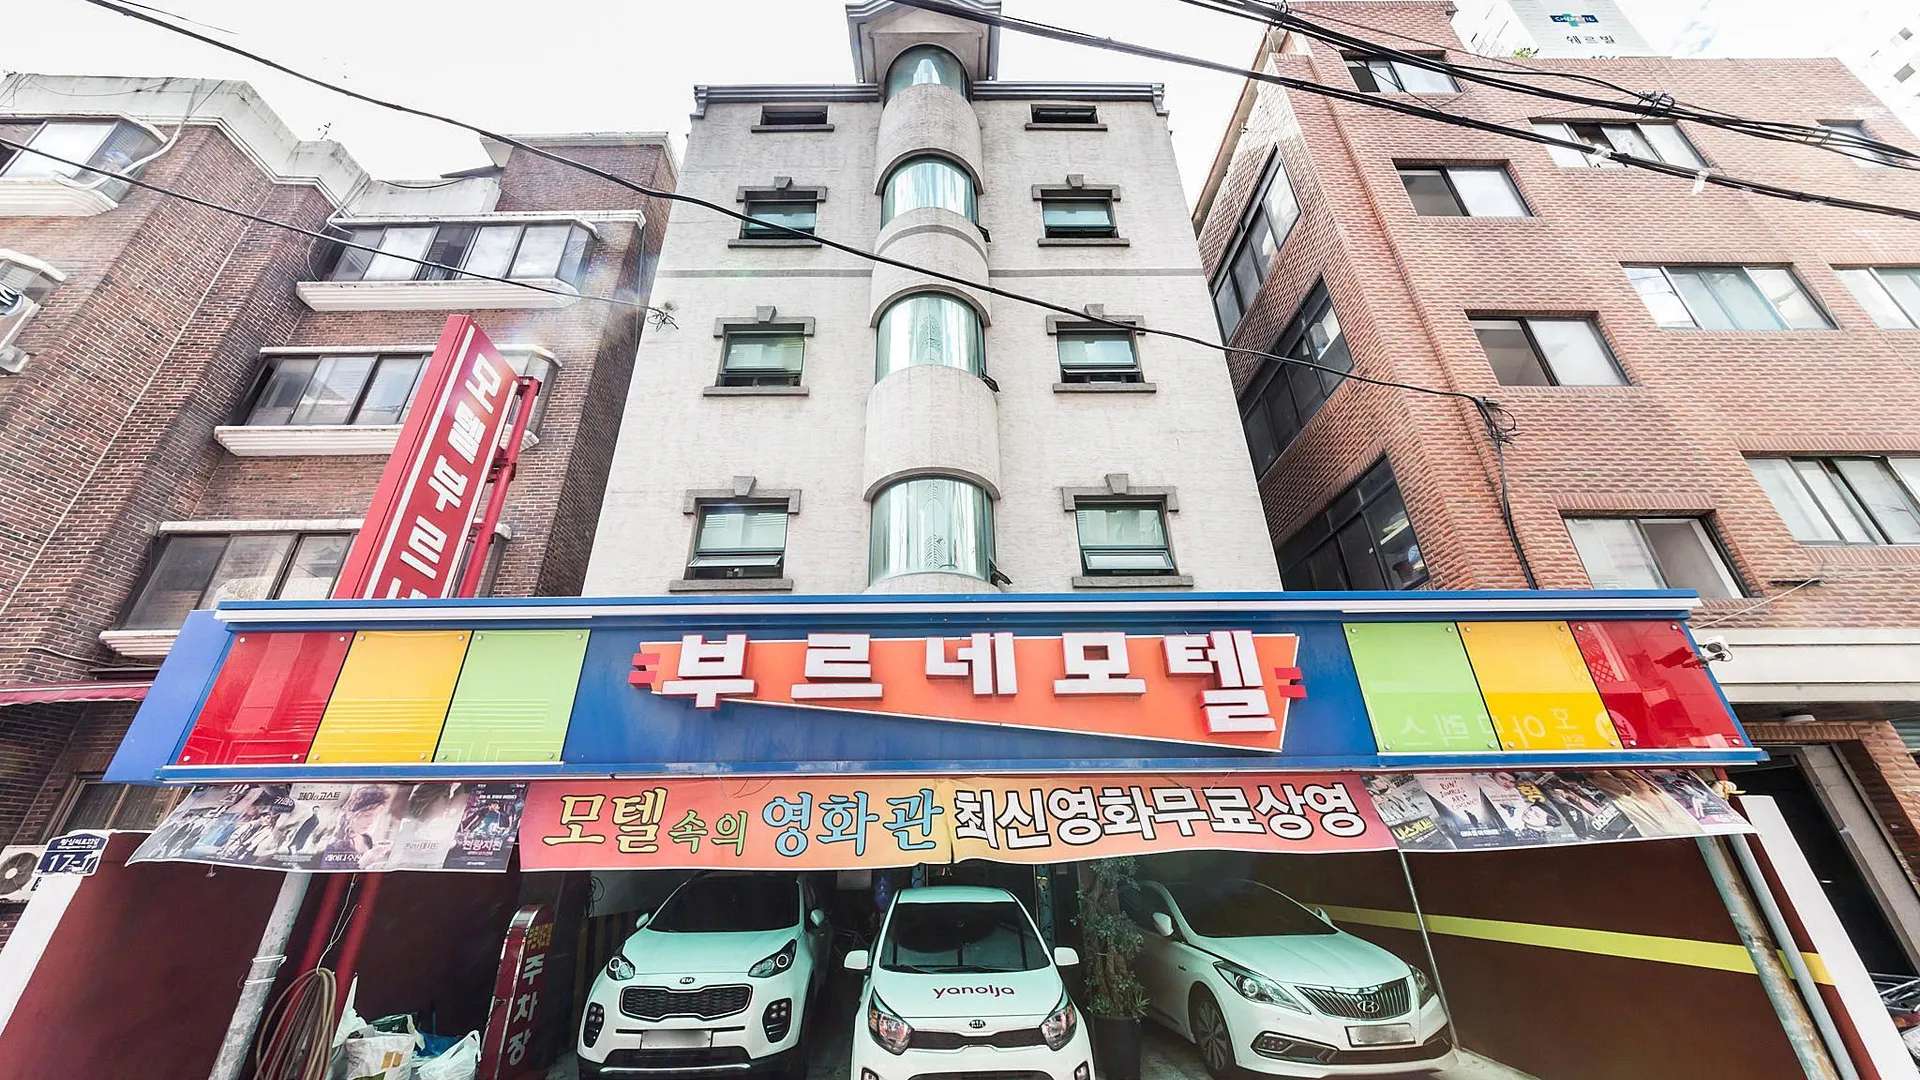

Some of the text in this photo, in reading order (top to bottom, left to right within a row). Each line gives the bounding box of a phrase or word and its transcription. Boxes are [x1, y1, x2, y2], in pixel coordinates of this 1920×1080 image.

[385, 352, 503, 600] 모텔부르
[661, 630, 1277, 735] 부르네모텔
[542, 786, 945, 858] 모텔 속의 영화관
[954, 782, 1368, 850] 최신영화무료상영
[507, 952, 546, 1066] 주차장
[932, 984, 1015, 999] yanolja
